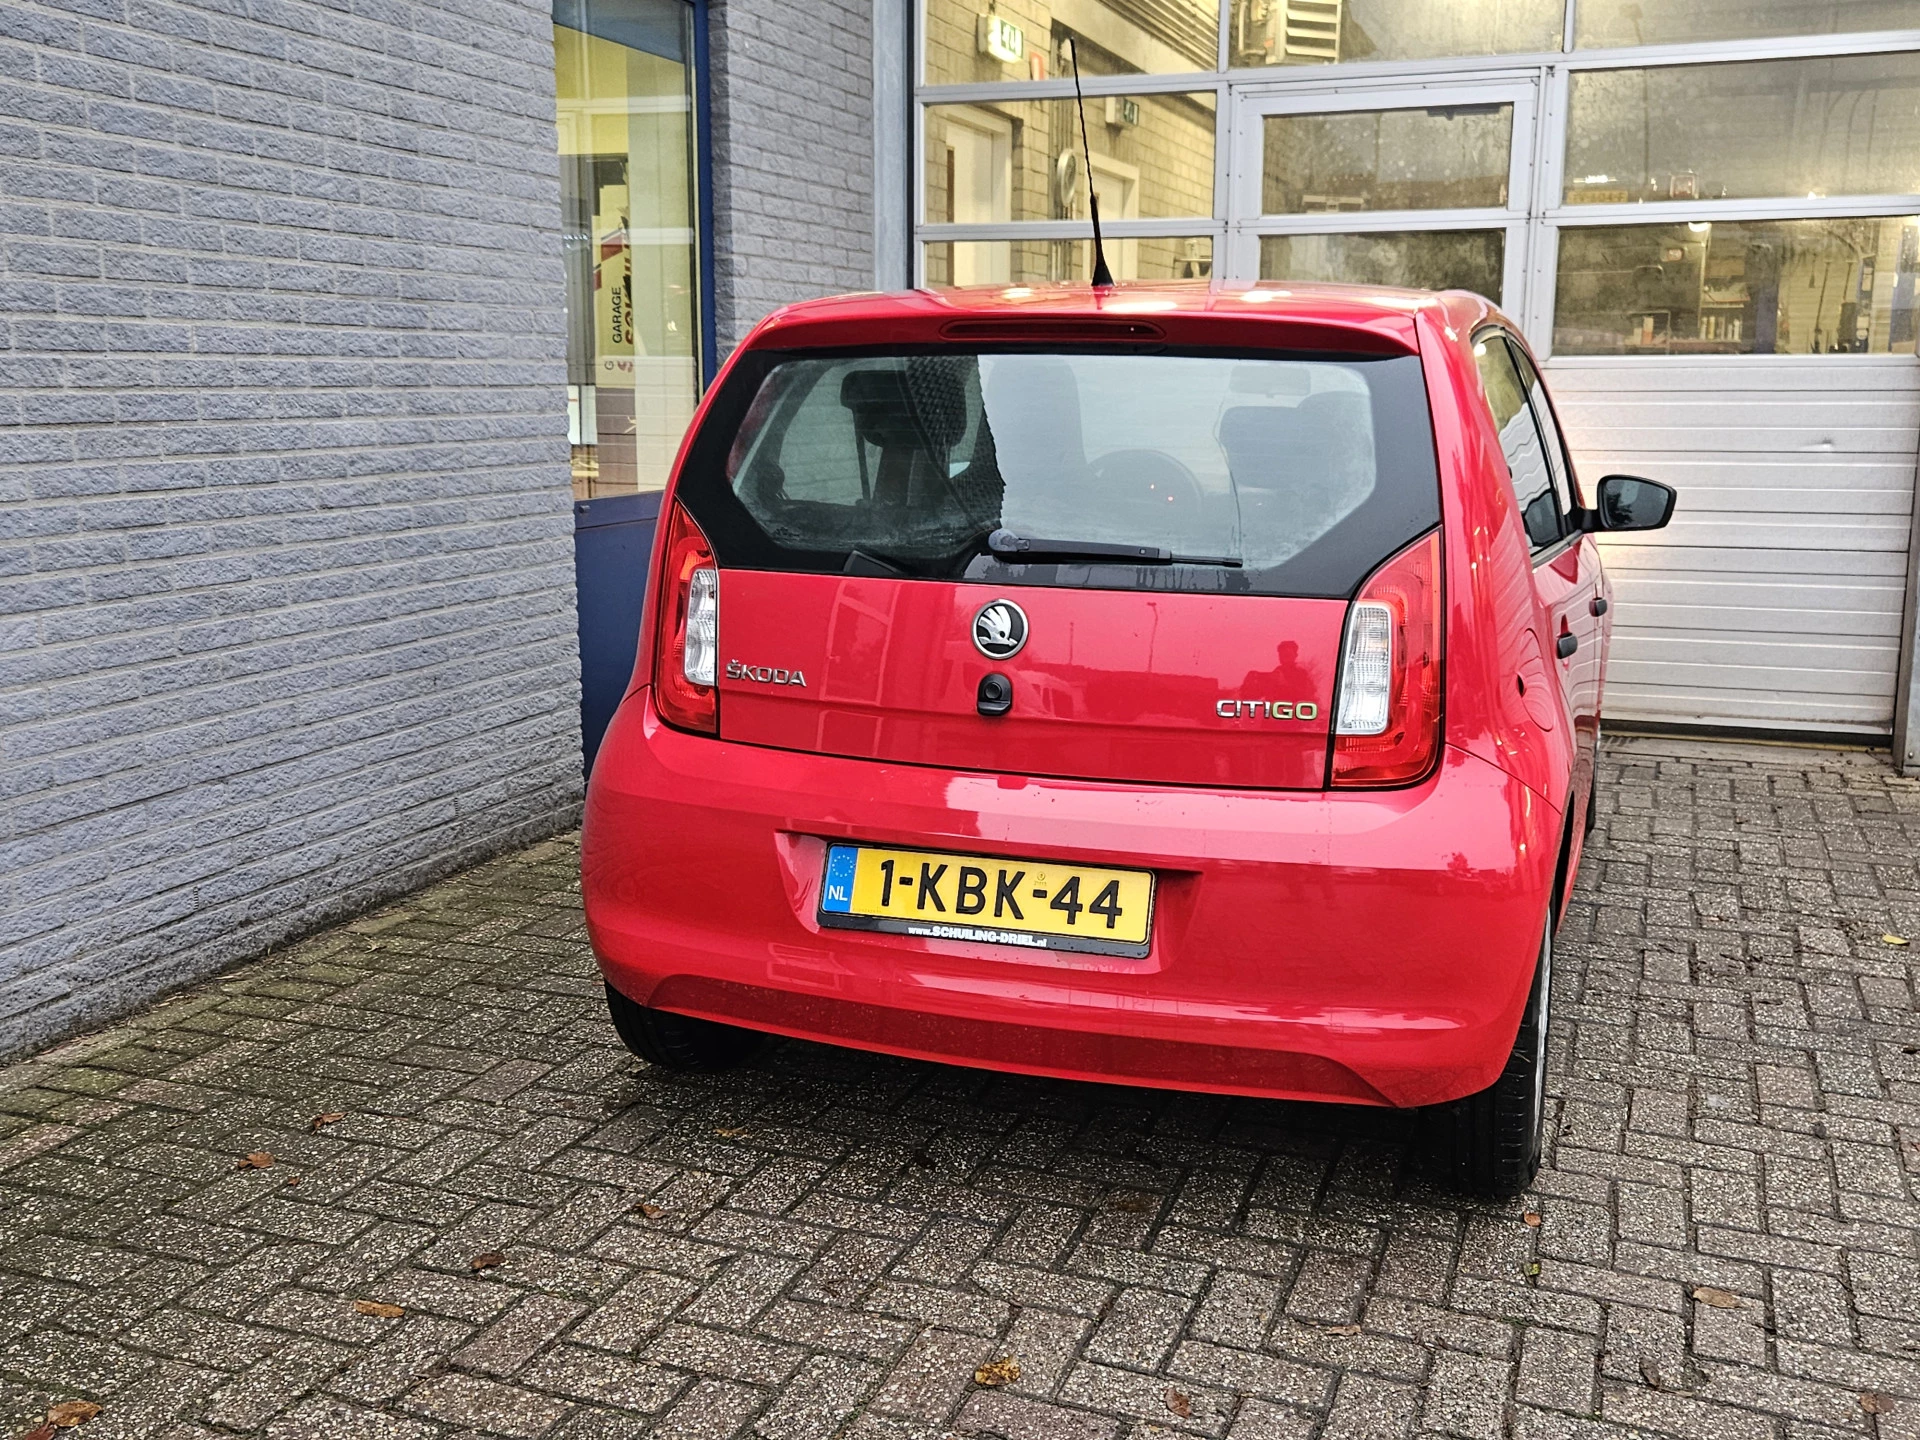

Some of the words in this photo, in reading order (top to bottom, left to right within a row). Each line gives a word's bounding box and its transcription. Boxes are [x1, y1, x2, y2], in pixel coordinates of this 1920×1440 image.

[611, 286, 622, 344] GARAGE
[726, 659, 807, 687] ŠKODA
[1216, 699, 1318, 720] CITIGO
[828, 884, 849, 902] NL
[880, 859, 1124, 929] 1-KBK-44
[908, 925, 1047, 948] www.SCHUILING-DRIEL.nl
